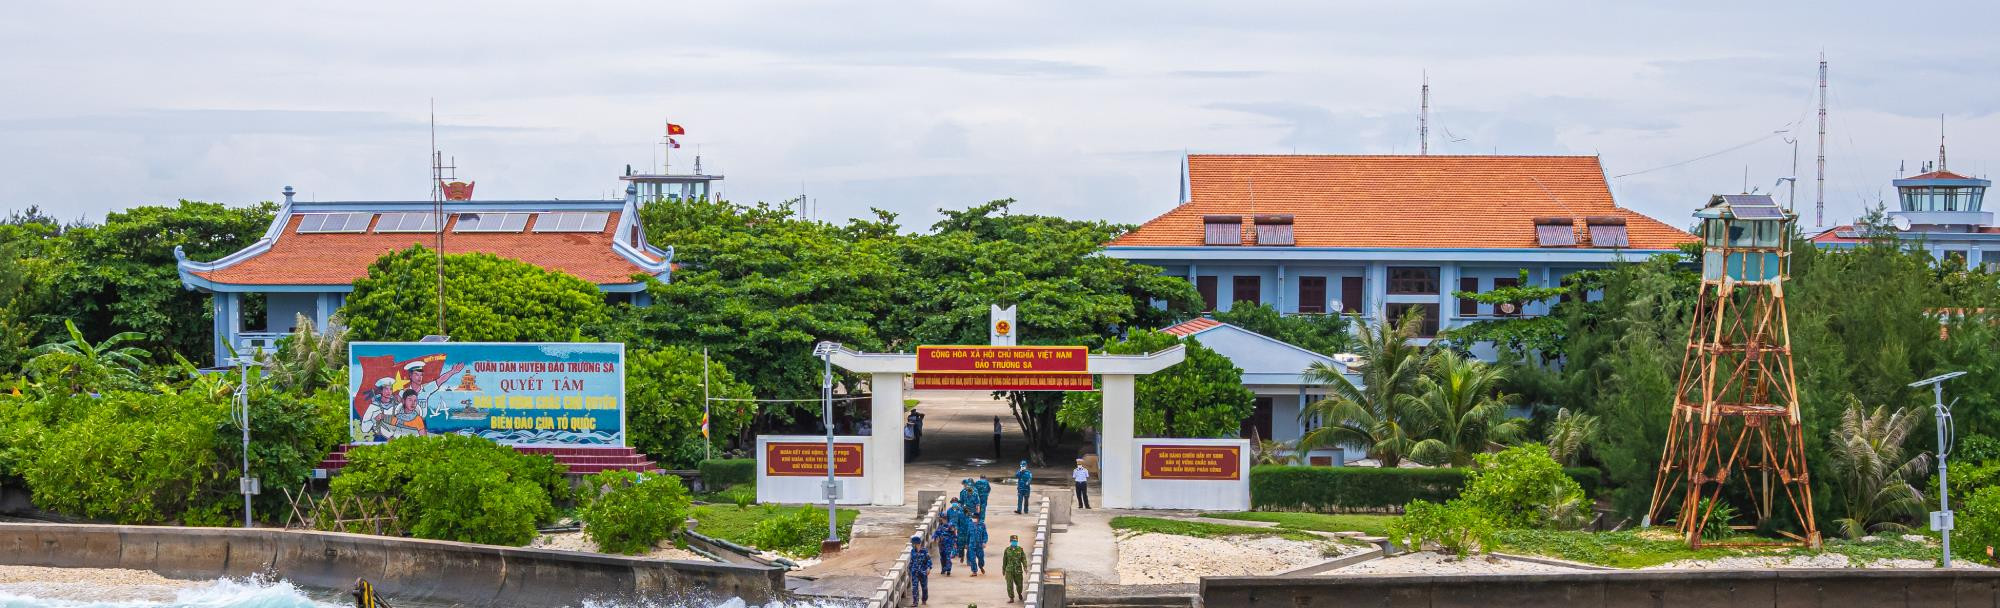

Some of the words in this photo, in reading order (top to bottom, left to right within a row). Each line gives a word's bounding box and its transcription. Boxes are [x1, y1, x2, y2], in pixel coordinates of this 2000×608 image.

[931, 350, 950, 360] CỘNG
[952, 350, 967, 358] HÒA
[983, 349, 994, 360] HỘI
[998, 348, 1011, 358] CHỦ
[1014, 350, 1034, 359] NGHĨA
[1038, 350, 1052, 360] VIỆT
[1056, 351, 1072, 359] NAM
[474, 360, 496, 372] QUÂN
[500, 360, 516, 372] DÂN
[519, 362, 545, 374] HUYỆN
[548, 360, 564, 372] ĐẢO
[568, 360, 600, 372] TRƯỜNG
[603, 362, 614, 372] SA
[974, 359, 989, 368] ĐẢO
[992, 359, 1020, 369] TRƯỜNG
[500, 374, 543, 392] QUYẾT
[552, 376, 584, 390] TÂM
[490, 410, 512, 430] BIỂN
[514, 412, 534, 430] ĐẢO
[536, 412, 554, 430] CỦA
[557, 412, 568, 430] TỔ
[570, 410, 596, 431] QUỐC
